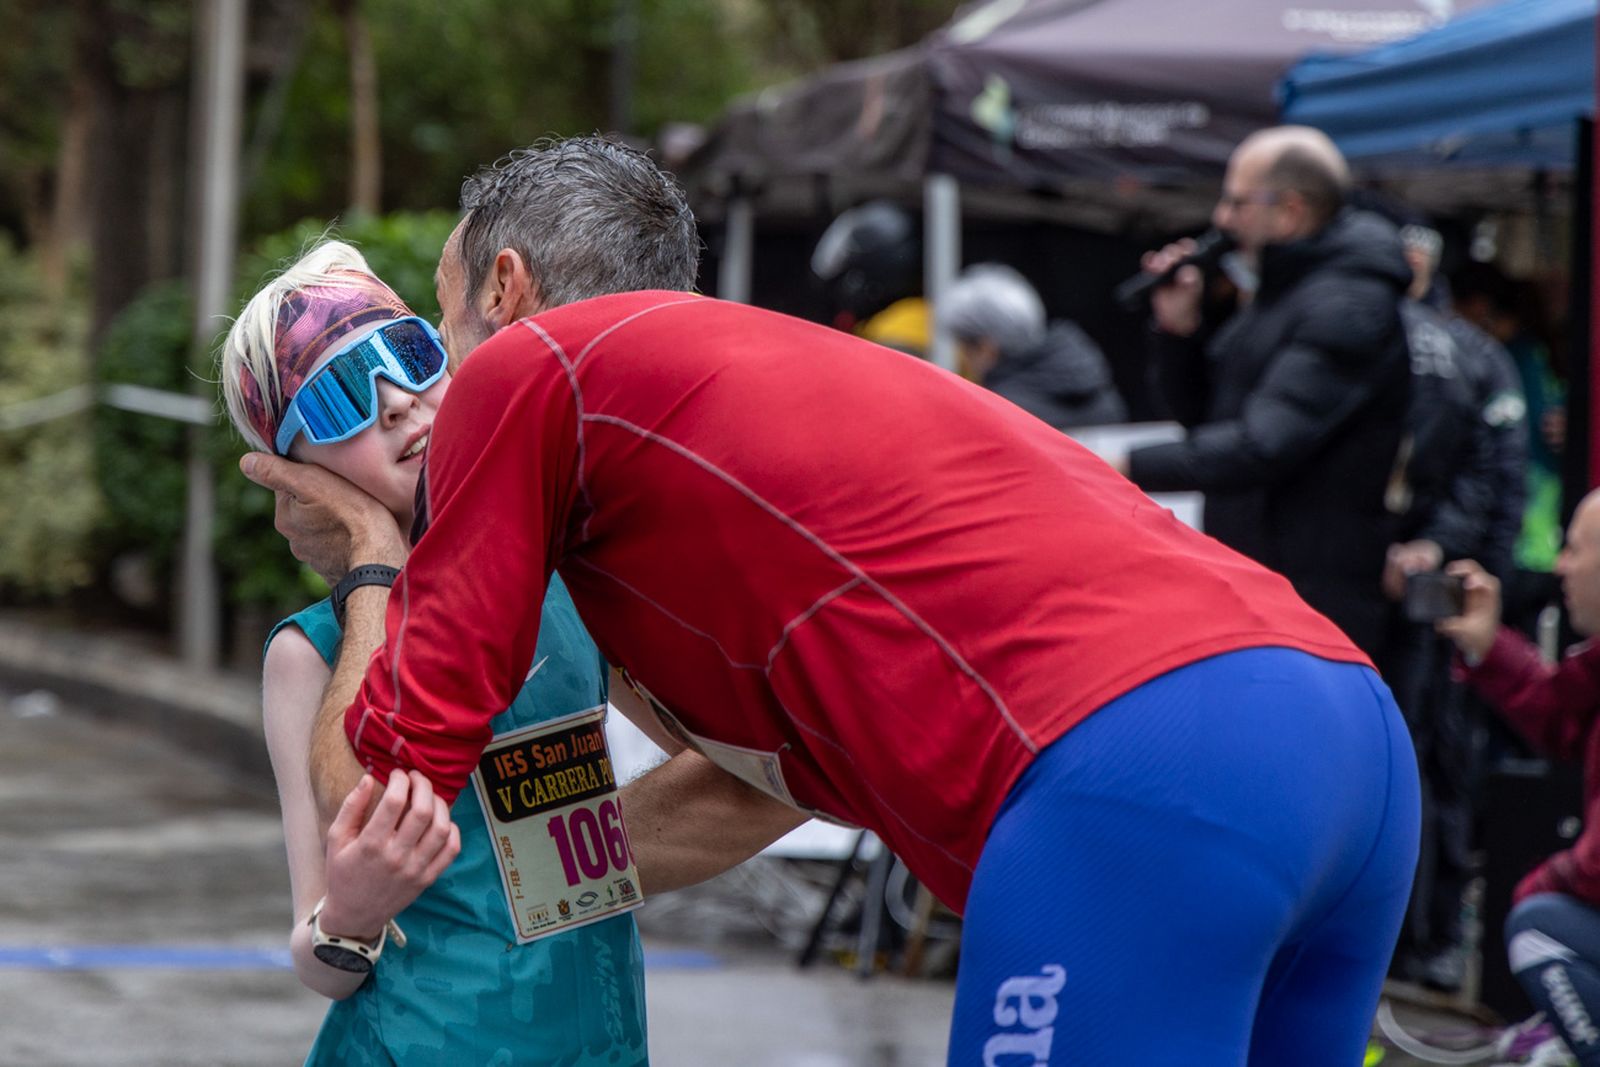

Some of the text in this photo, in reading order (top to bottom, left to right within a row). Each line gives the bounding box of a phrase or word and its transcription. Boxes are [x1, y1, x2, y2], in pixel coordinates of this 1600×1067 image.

[494, 731, 603, 780] IES San Juan
[496, 785, 513, 814] V
[519, 763, 600, 808] CARRERA
[547, 796, 635, 887] 106
